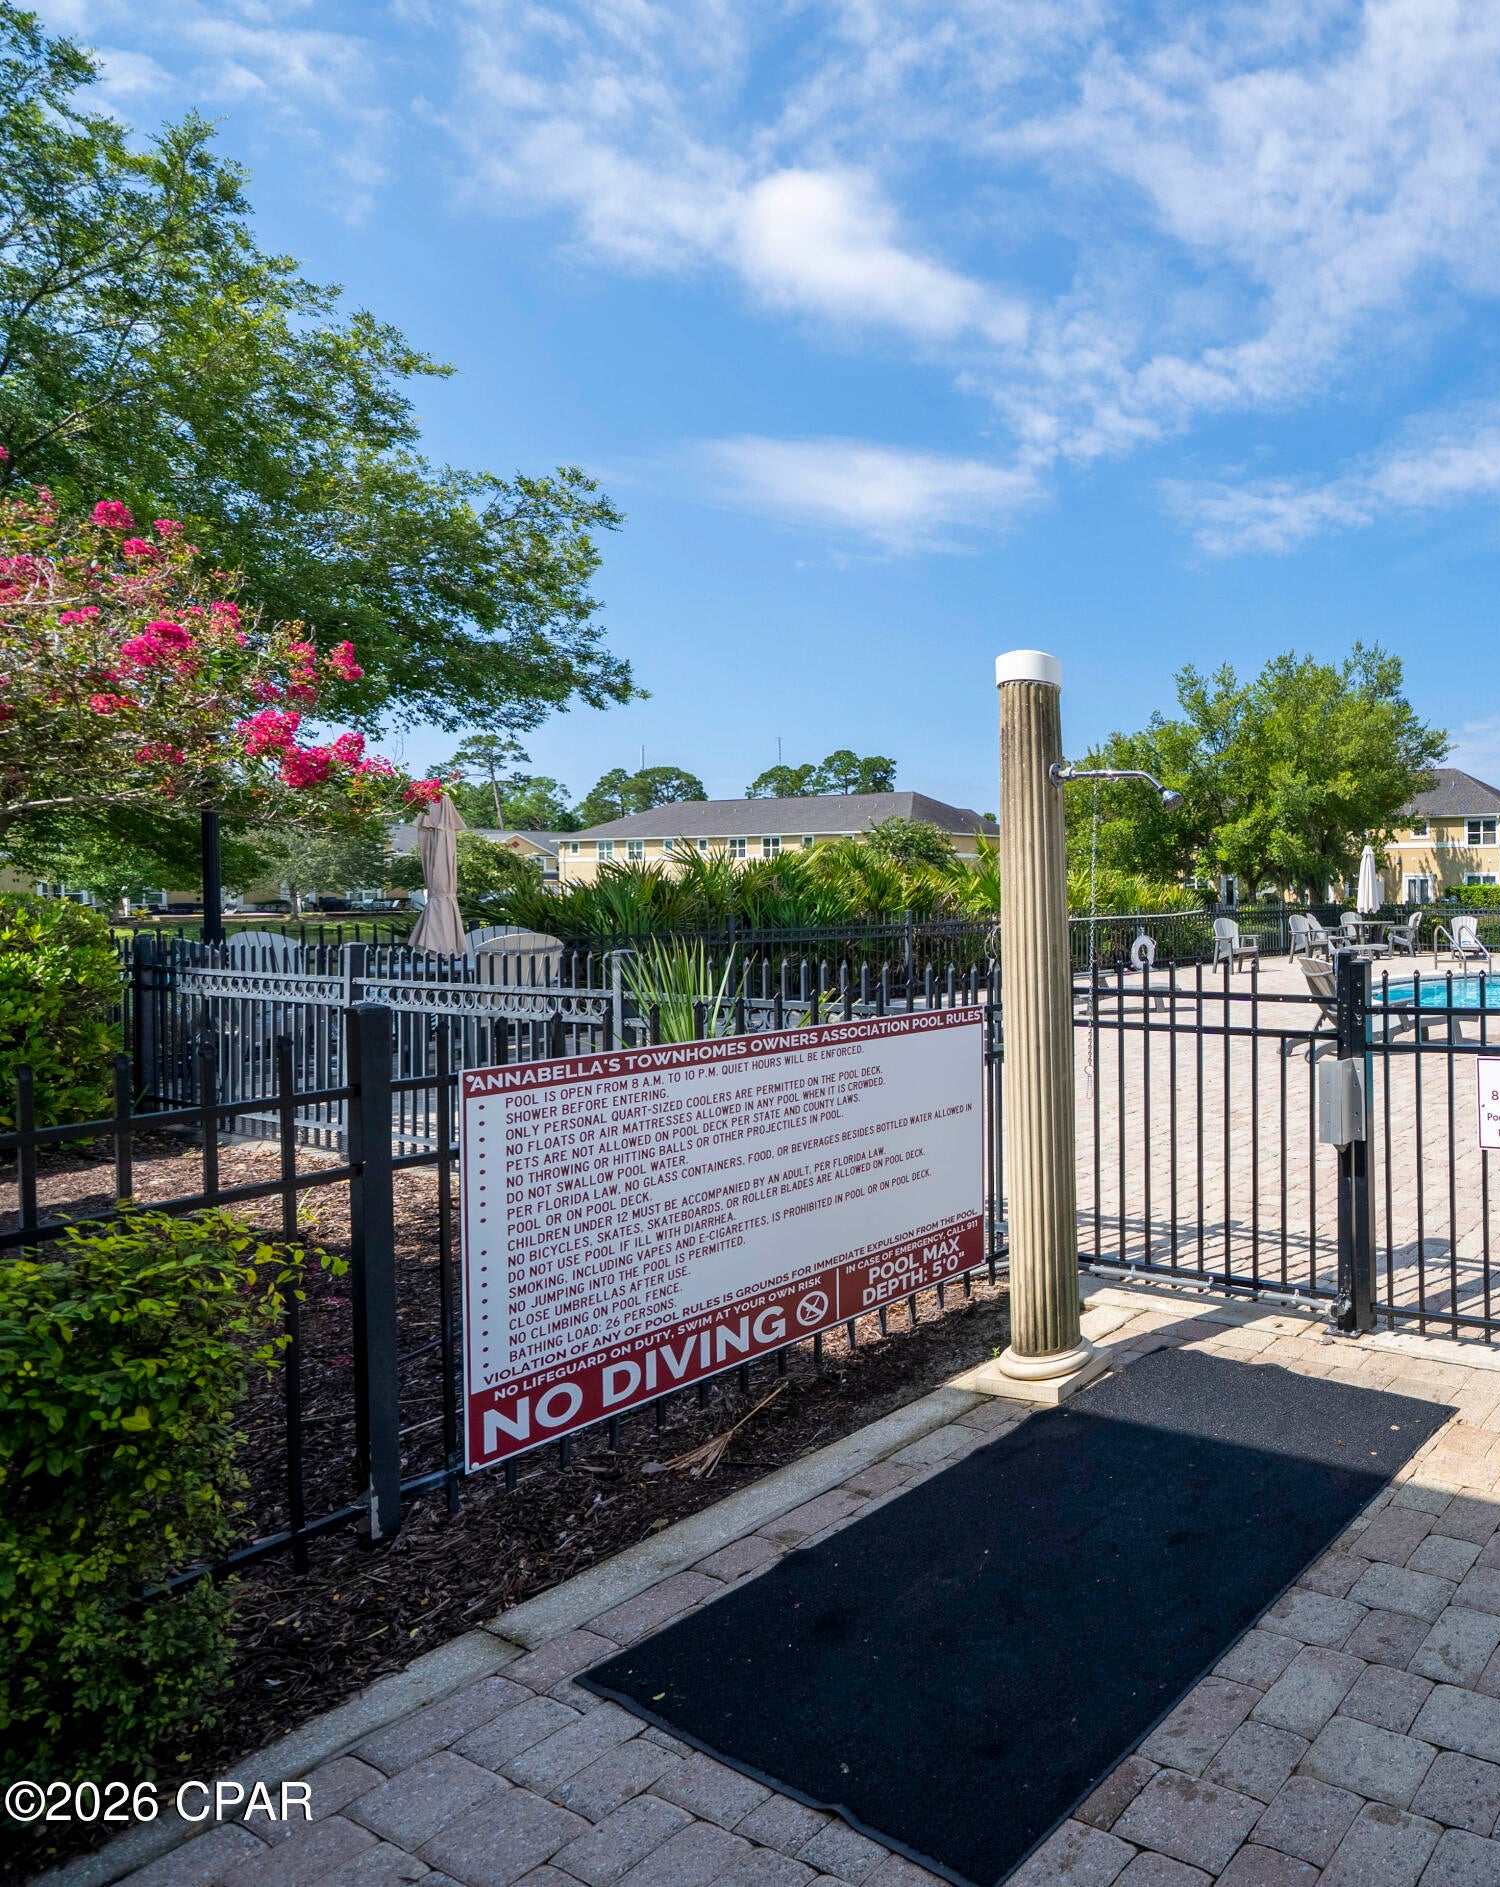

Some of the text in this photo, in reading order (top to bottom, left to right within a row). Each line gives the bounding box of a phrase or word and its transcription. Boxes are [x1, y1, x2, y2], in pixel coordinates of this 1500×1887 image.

[470, 1009, 980, 1092] ANNABELLA'S TOWNHOMES OWNERS ASSOCIATION POOL RULES
[504, 1044, 864, 1109] POOL IS OPEN FROM 8 A.M. TO 10 P.M. QUIET HOURS WILL BE ENFORCED.
[505, 1064, 883, 1141] ONLY PERSONAL QUART-SIZED COOLERS ARE PERMITTED ON THE POOL DECK.
[505, 1092, 861, 1173] PETS ARE NOT ALLOWED ON POOL DECK PER STATE AND COUNTY LAWS.
[506, 1154, 689, 1205] DO NOT SWALLOW POOL WATER.
[506, 1146, 886, 1252] CHILDREN UNDER 12 MUST BE ACCOMPANIED BY AN ADULT, PER FLORIDA LAW.
[506, 1191, 653, 1237] POOL OR ON POOL DECK.
[507, 1211, 736, 1284] DO NOT USE POOL IF ILL WITH DIARRHEA.
[508, 1235, 746, 1316] NO JUMPING INTO THE POOL IS PERMITTED.
[845, 1218, 978, 1275] IN CASE OF EMERGENCY, CALL 911
[868, 1235, 960, 1285] POOL MAX
[482, 1208, 978, 1386] VIOLATION OF ANY OF POOL RULES IS GROUNDS FOR IMMEDIATE EXPULSION FROM THE POOL.
[508, 1265, 691, 1331] CLOSE UMBRELLAS AFTER USE.
[508, 1281, 682, 1347] NO CLIMBING ON POOL FENCE.
[862, 1266, 928, 1306] DEPTH:
[493, 1275, 822, 1402] NO LIFEGUARD ON DUTY, SWIM AT YOUR OWN RISK
[508, 1297, 677, 1363] BATHING LOAD: 26 PERSONS.
[482, 1305, 786, 1455] NO DIVING
